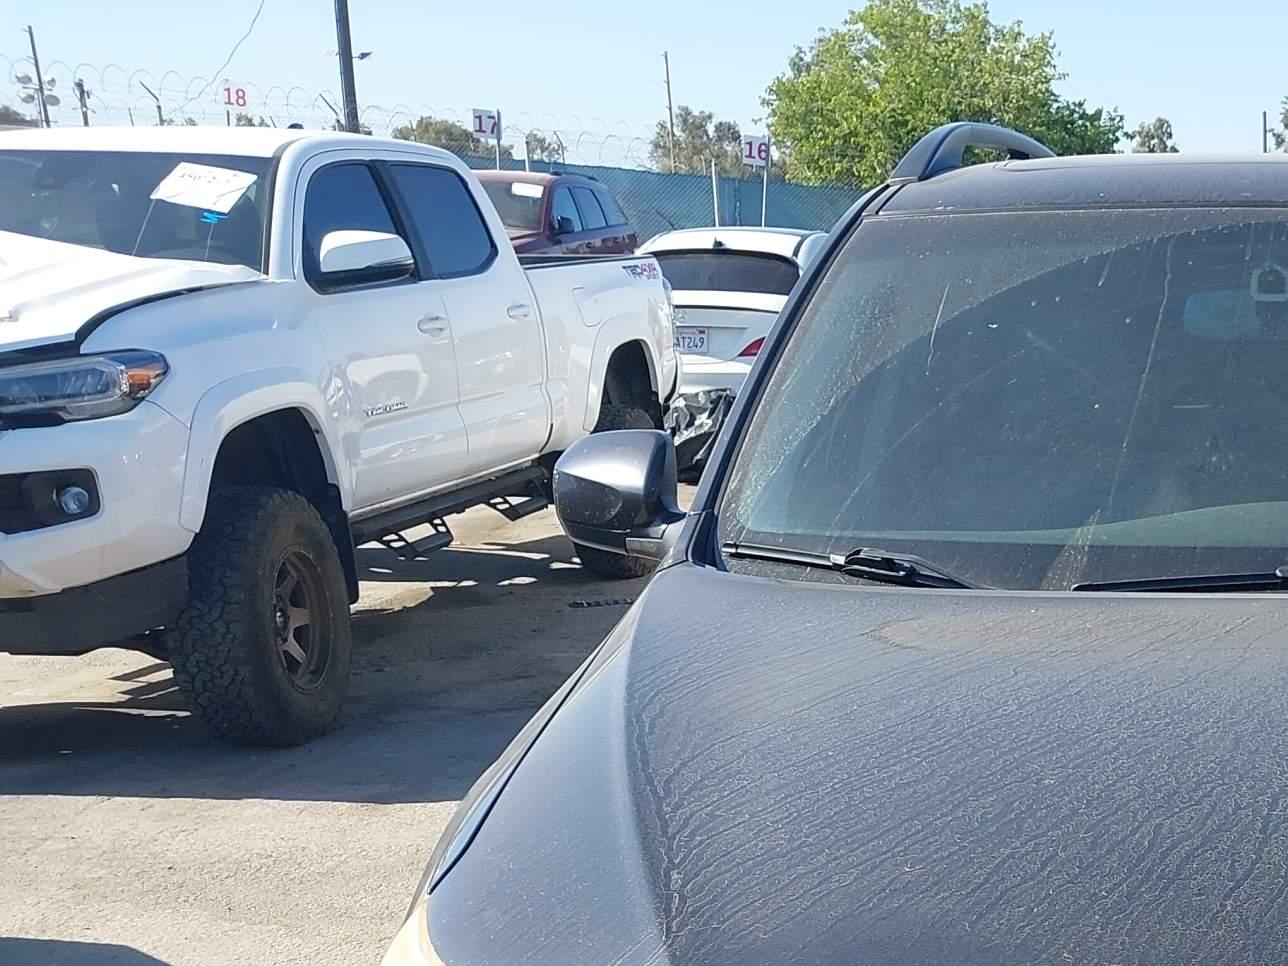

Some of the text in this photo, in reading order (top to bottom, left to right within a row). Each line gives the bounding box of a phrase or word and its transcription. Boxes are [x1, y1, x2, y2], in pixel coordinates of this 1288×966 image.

[223, 87, 247, 107] 18
[474, 115, 498, 135] 17
[744, 141, 769, 161] 16
